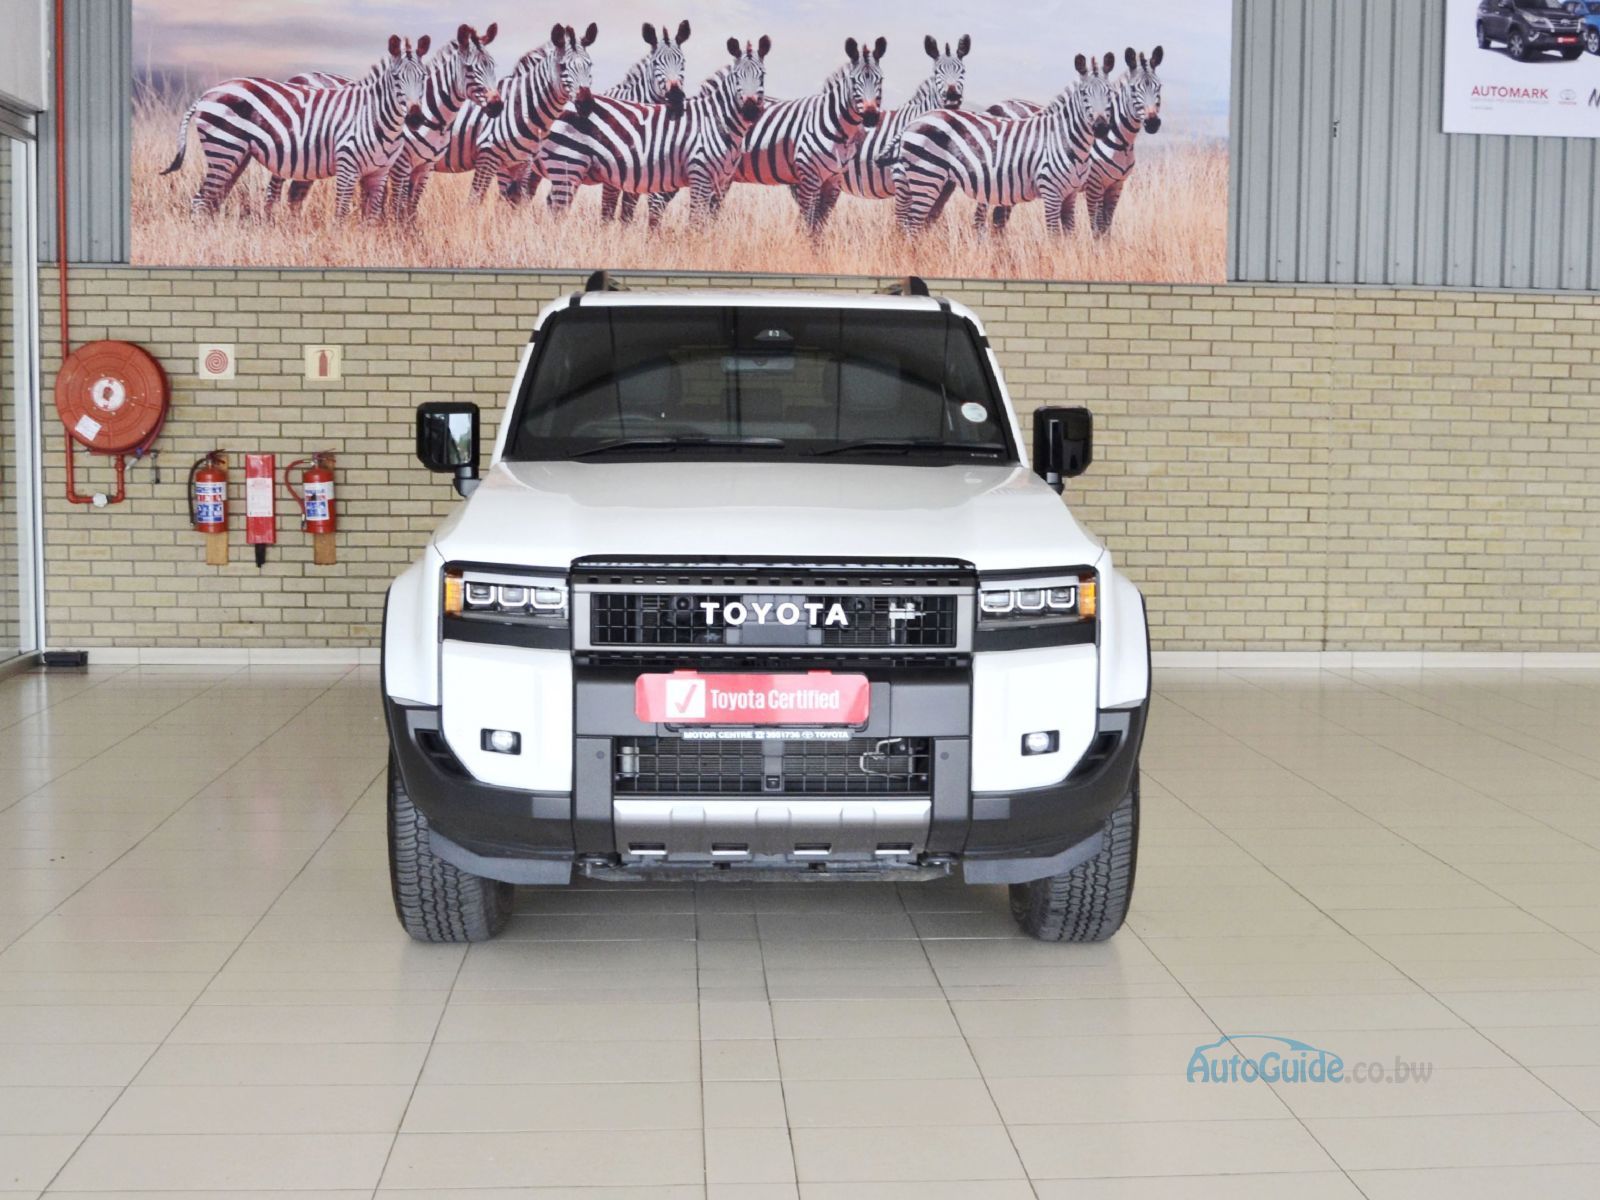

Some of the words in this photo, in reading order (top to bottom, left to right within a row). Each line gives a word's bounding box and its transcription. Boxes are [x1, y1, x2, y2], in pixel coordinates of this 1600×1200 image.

[1471, 85, 1549, 99] AUTOMARK
[700, 602, 849, 626] TOYOTA
[710, 689, 765, 711] Toyota
[768, 689, 840, 709] Certified
[683, 731, 716, 739] MOTOR
[718, 731, 753, 739] CENTRE
[815, 731, 849, 739] TOYOTA
